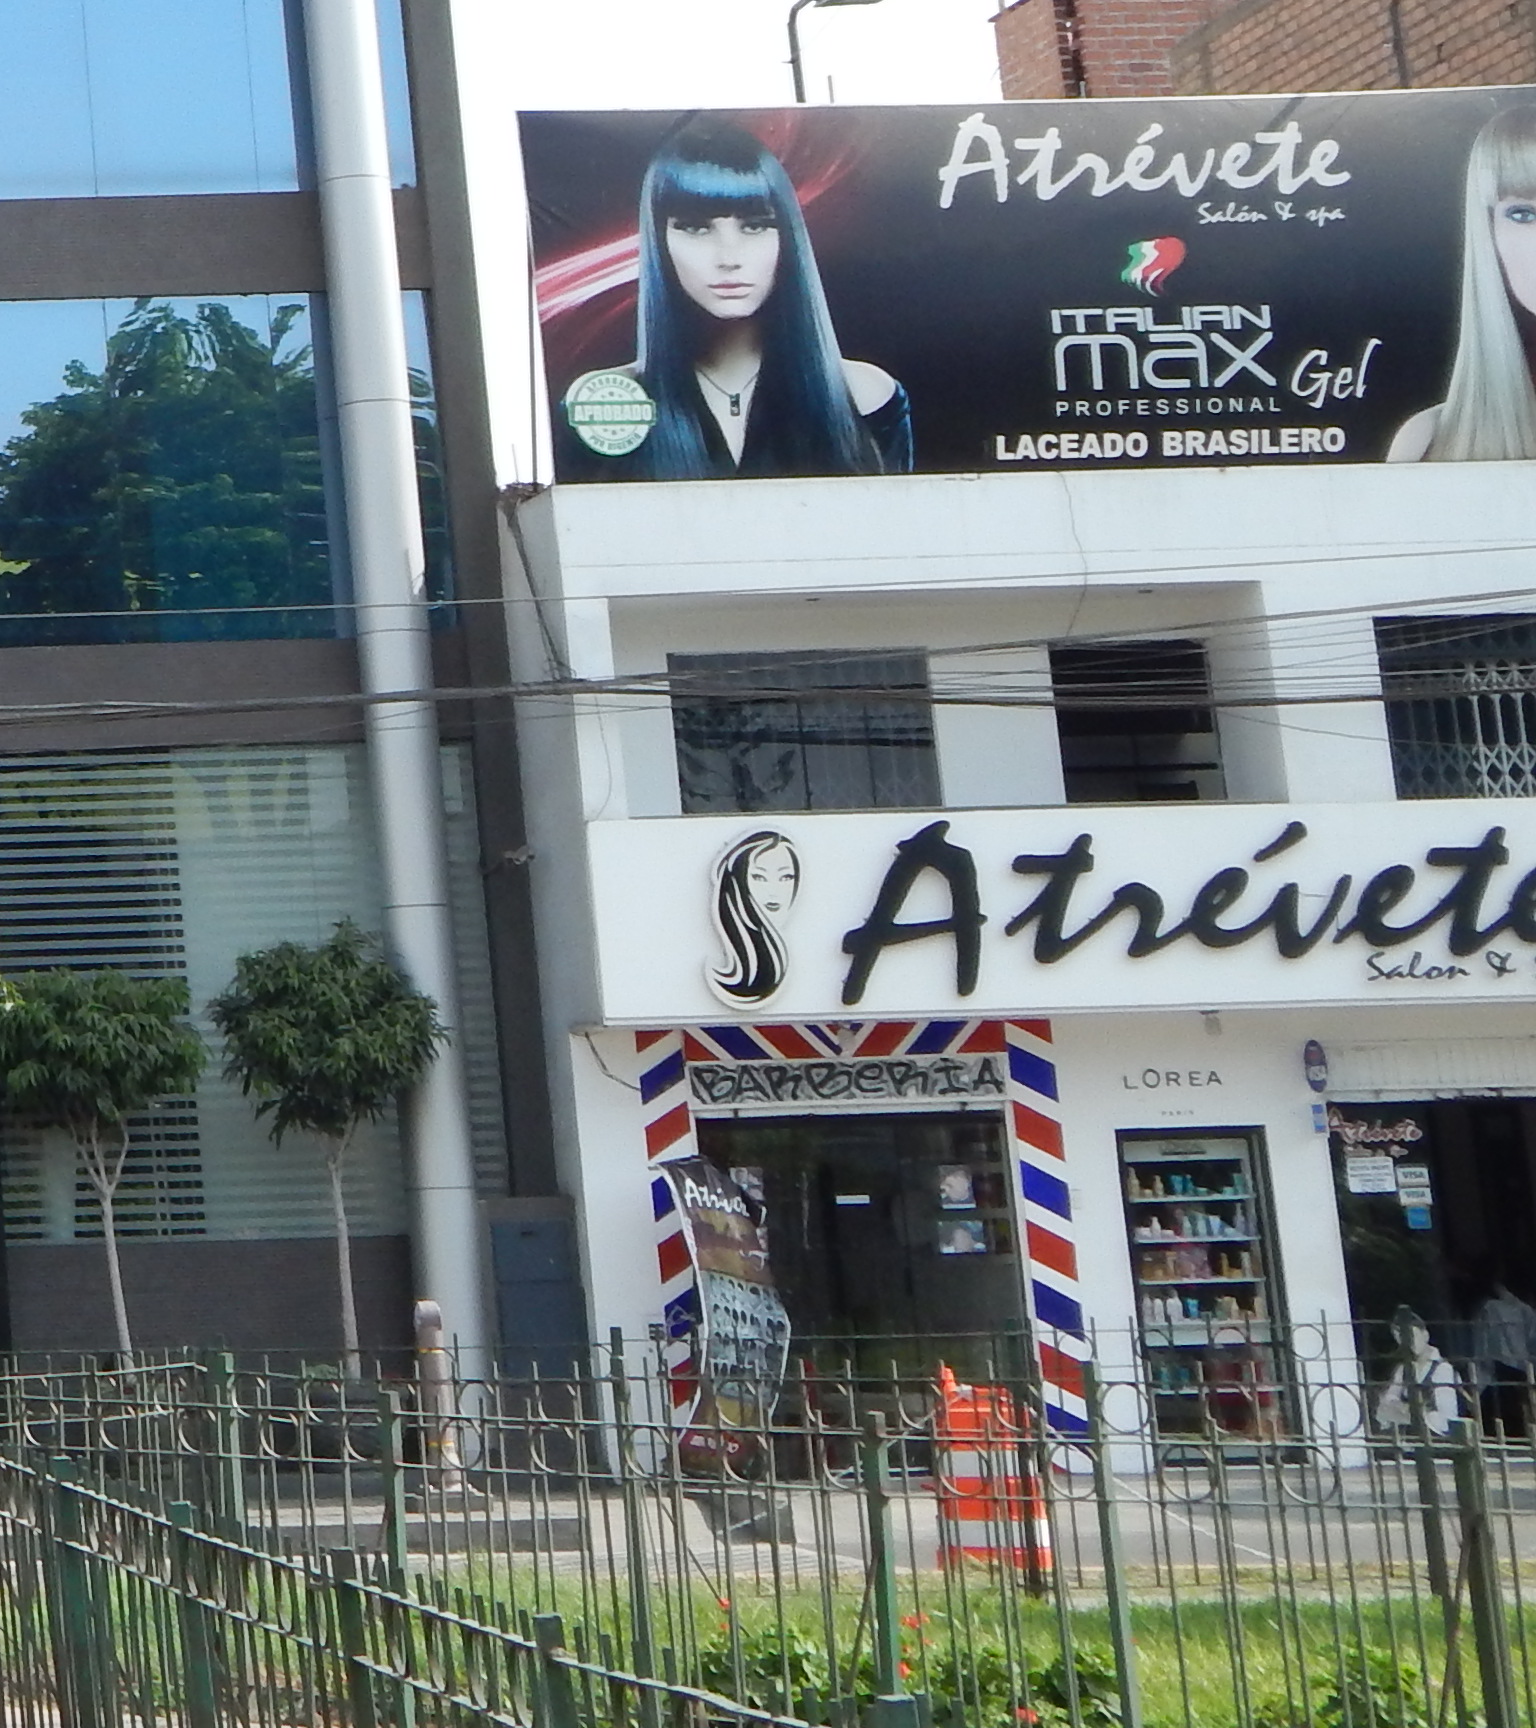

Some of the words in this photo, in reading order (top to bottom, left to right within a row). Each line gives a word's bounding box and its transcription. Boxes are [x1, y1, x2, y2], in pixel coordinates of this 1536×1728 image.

[938, 112, 1351, 208] Atrévete
[1197, 201, 1268, 224] Salón
[1305, 206, 1346, 227] spa
[1050, 305, 1272, 334] ITALIAN
[1290, 338, 1382, 409] Gel
[1055, 397, 1281, 417] PROFESSIONAL
[996, 432, 1148, 461] LACEADO
[1162, 427, 1346, 457] BRASILERO
[1366, 951, 1470, 981] Salon
